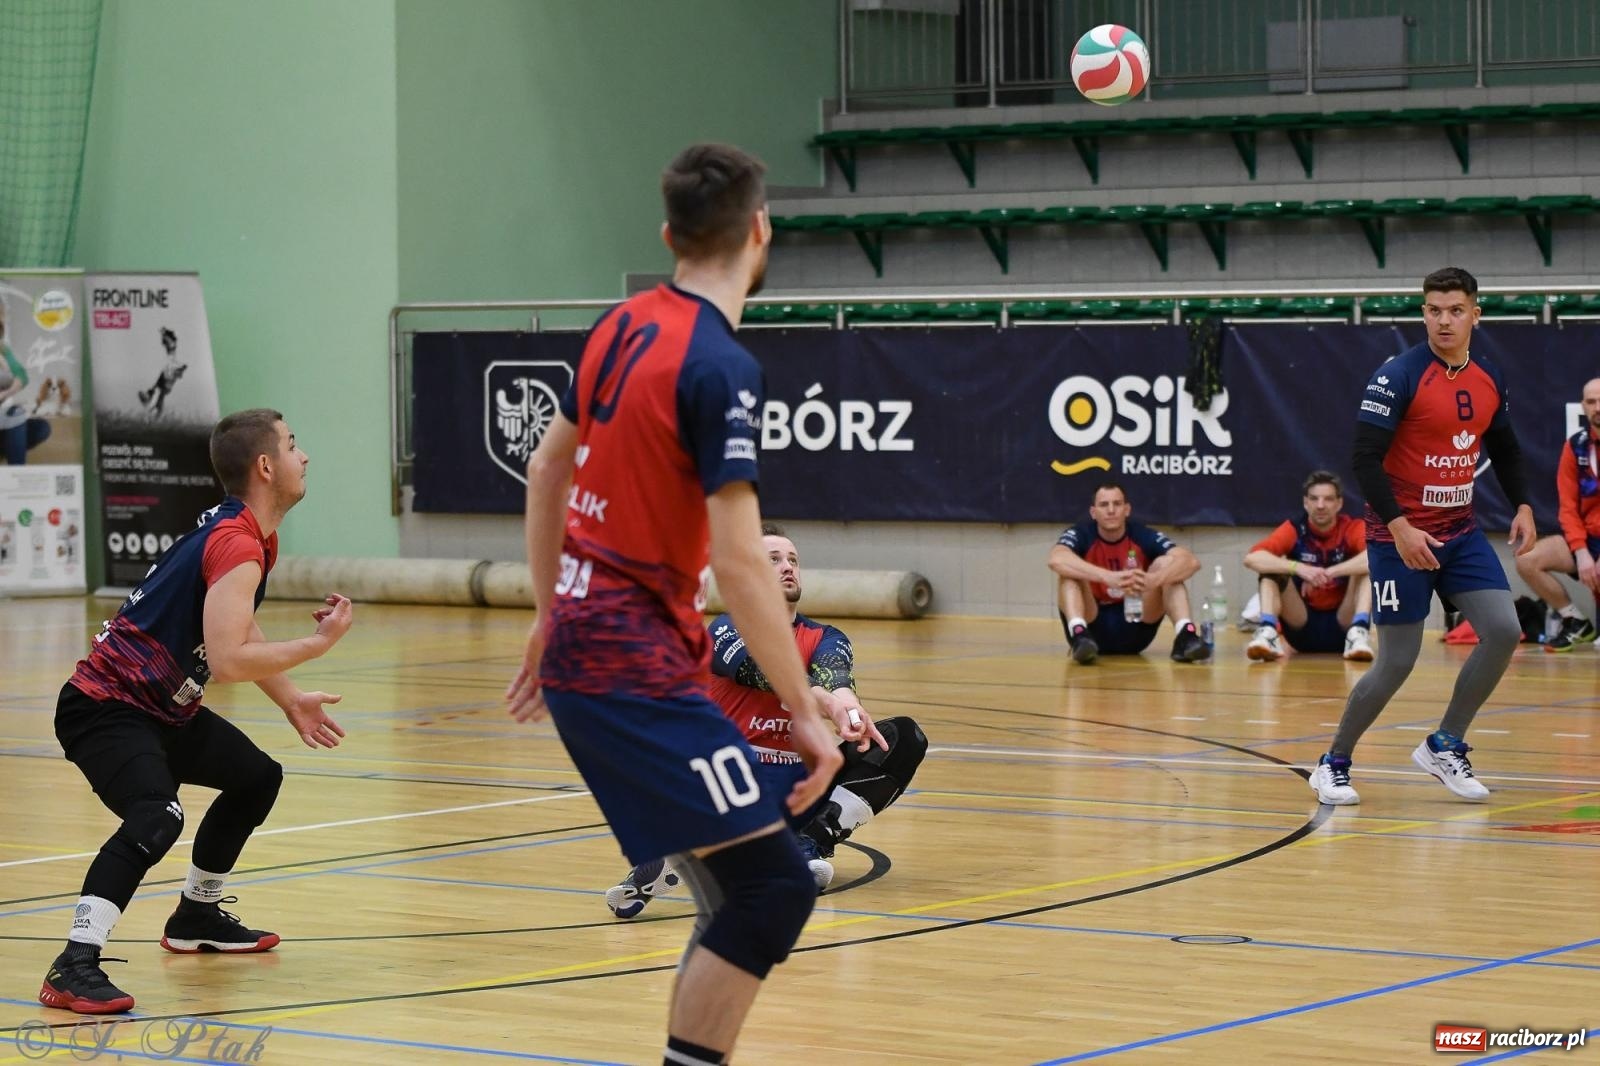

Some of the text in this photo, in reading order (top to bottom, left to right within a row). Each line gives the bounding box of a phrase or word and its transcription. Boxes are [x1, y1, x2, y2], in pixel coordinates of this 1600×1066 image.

[92, 288, 168, 308] FRONTLINE
[761, 382, 914, 451] BÓRZ
[1456, 390, 1474, 421] 8
[1122, 449, 1232, 475] RACIBÓRZ
[1440, 469, 1471, 479] GROU
[1425, 486, 1471, 505] nowiny
[1373, 580, 1400, 612] 14
[689, 745, 761, 816] 10
